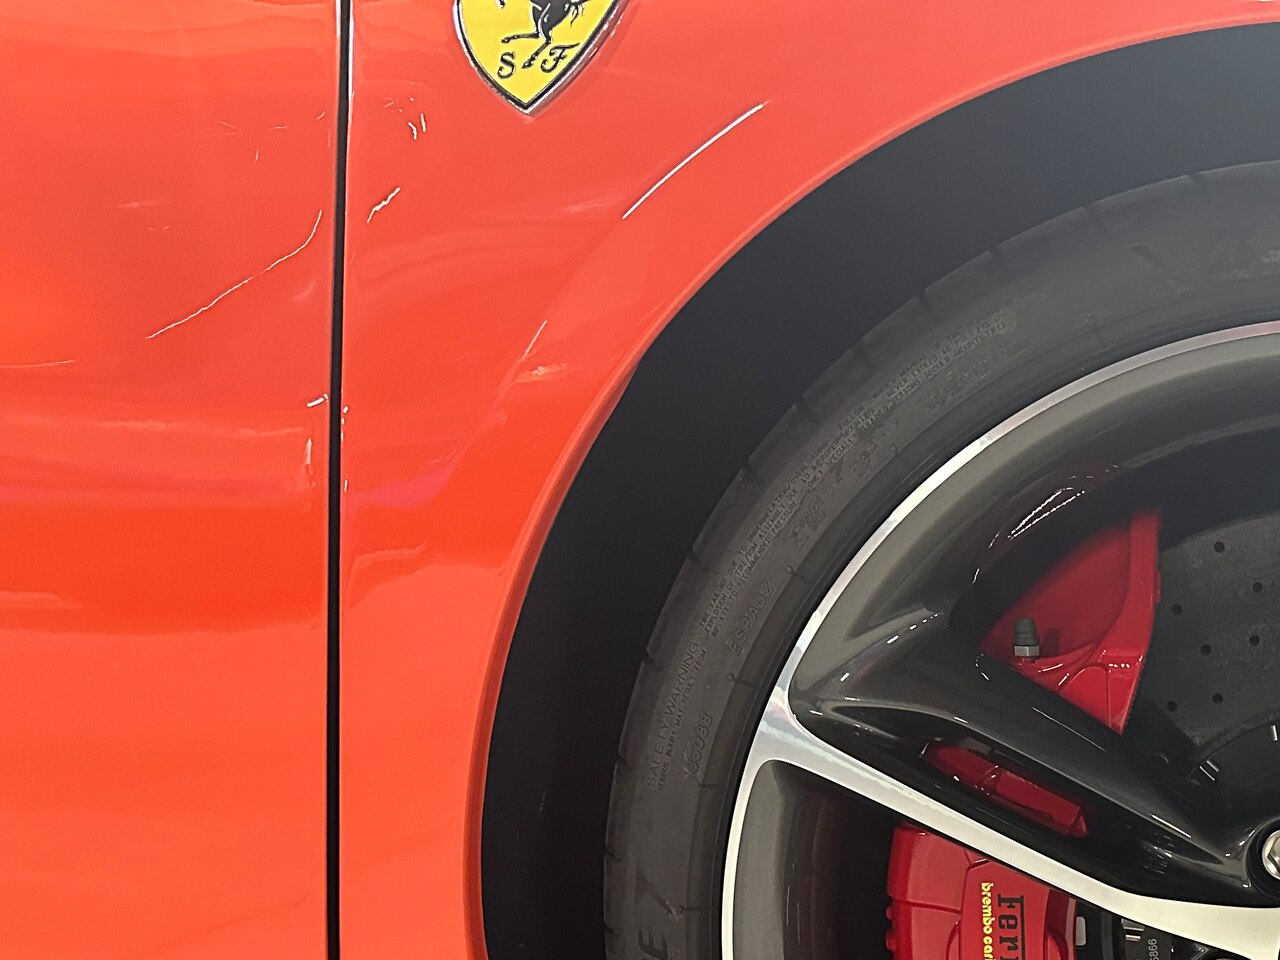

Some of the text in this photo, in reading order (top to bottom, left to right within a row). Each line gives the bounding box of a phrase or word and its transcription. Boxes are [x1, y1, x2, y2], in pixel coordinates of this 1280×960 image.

[497, 42, 581, 79] S F
[663, 636, 700, 720] WARNING
[981, 882, 995, 934] brembo
